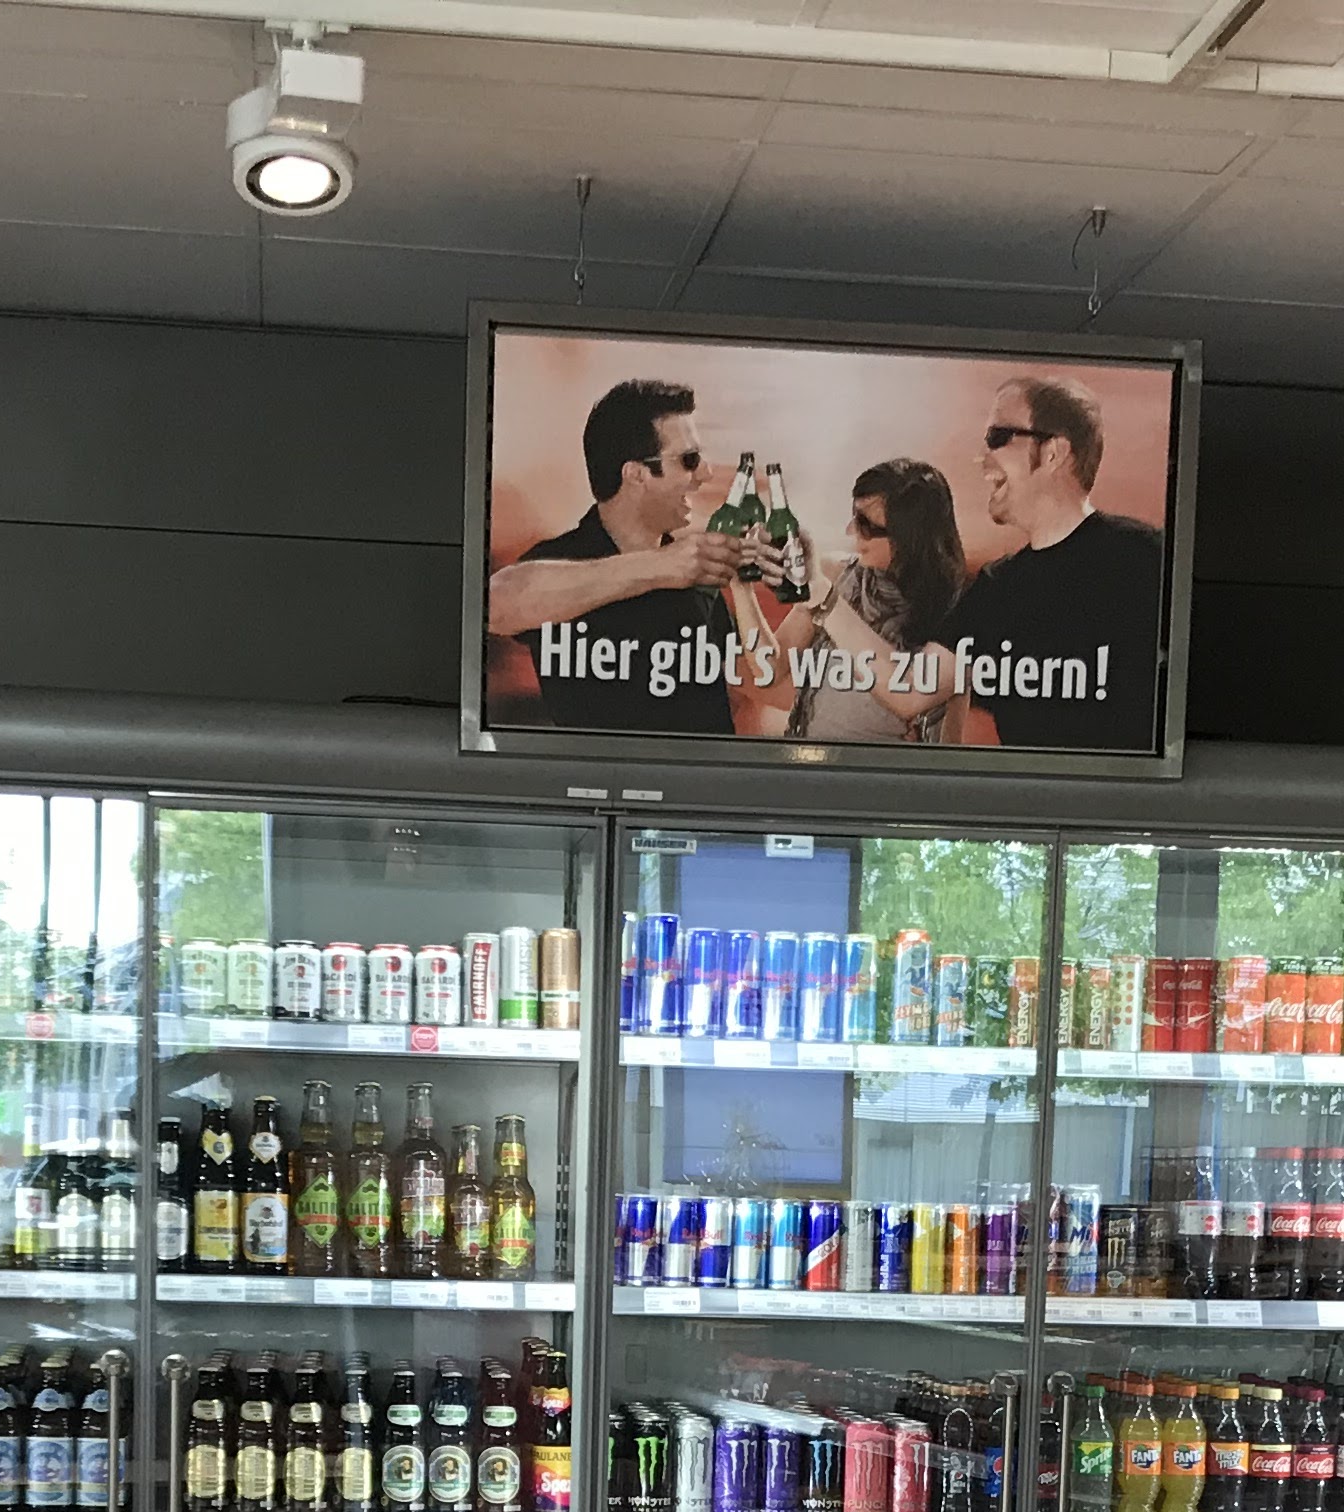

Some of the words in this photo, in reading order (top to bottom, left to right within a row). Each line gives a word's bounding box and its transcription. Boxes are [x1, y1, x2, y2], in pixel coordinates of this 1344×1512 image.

[539, 622, 640, 681] Hier
[649, 626, 776, 698] gibt's
[789, 647, 876, 693] was
[887, 649, 940, 695] zu
[955, 638, 1111, 700] feiern!
[472, 948, 490, 1016] SMIRNOFF
[1017, 991, 1030, 1046] ENERGY
[1058, 989, 1070, 1045] ENERGY
[1089, 987, 1103, 1046] ENERGY
[531, 1449, 571, 1461] PAULANE
